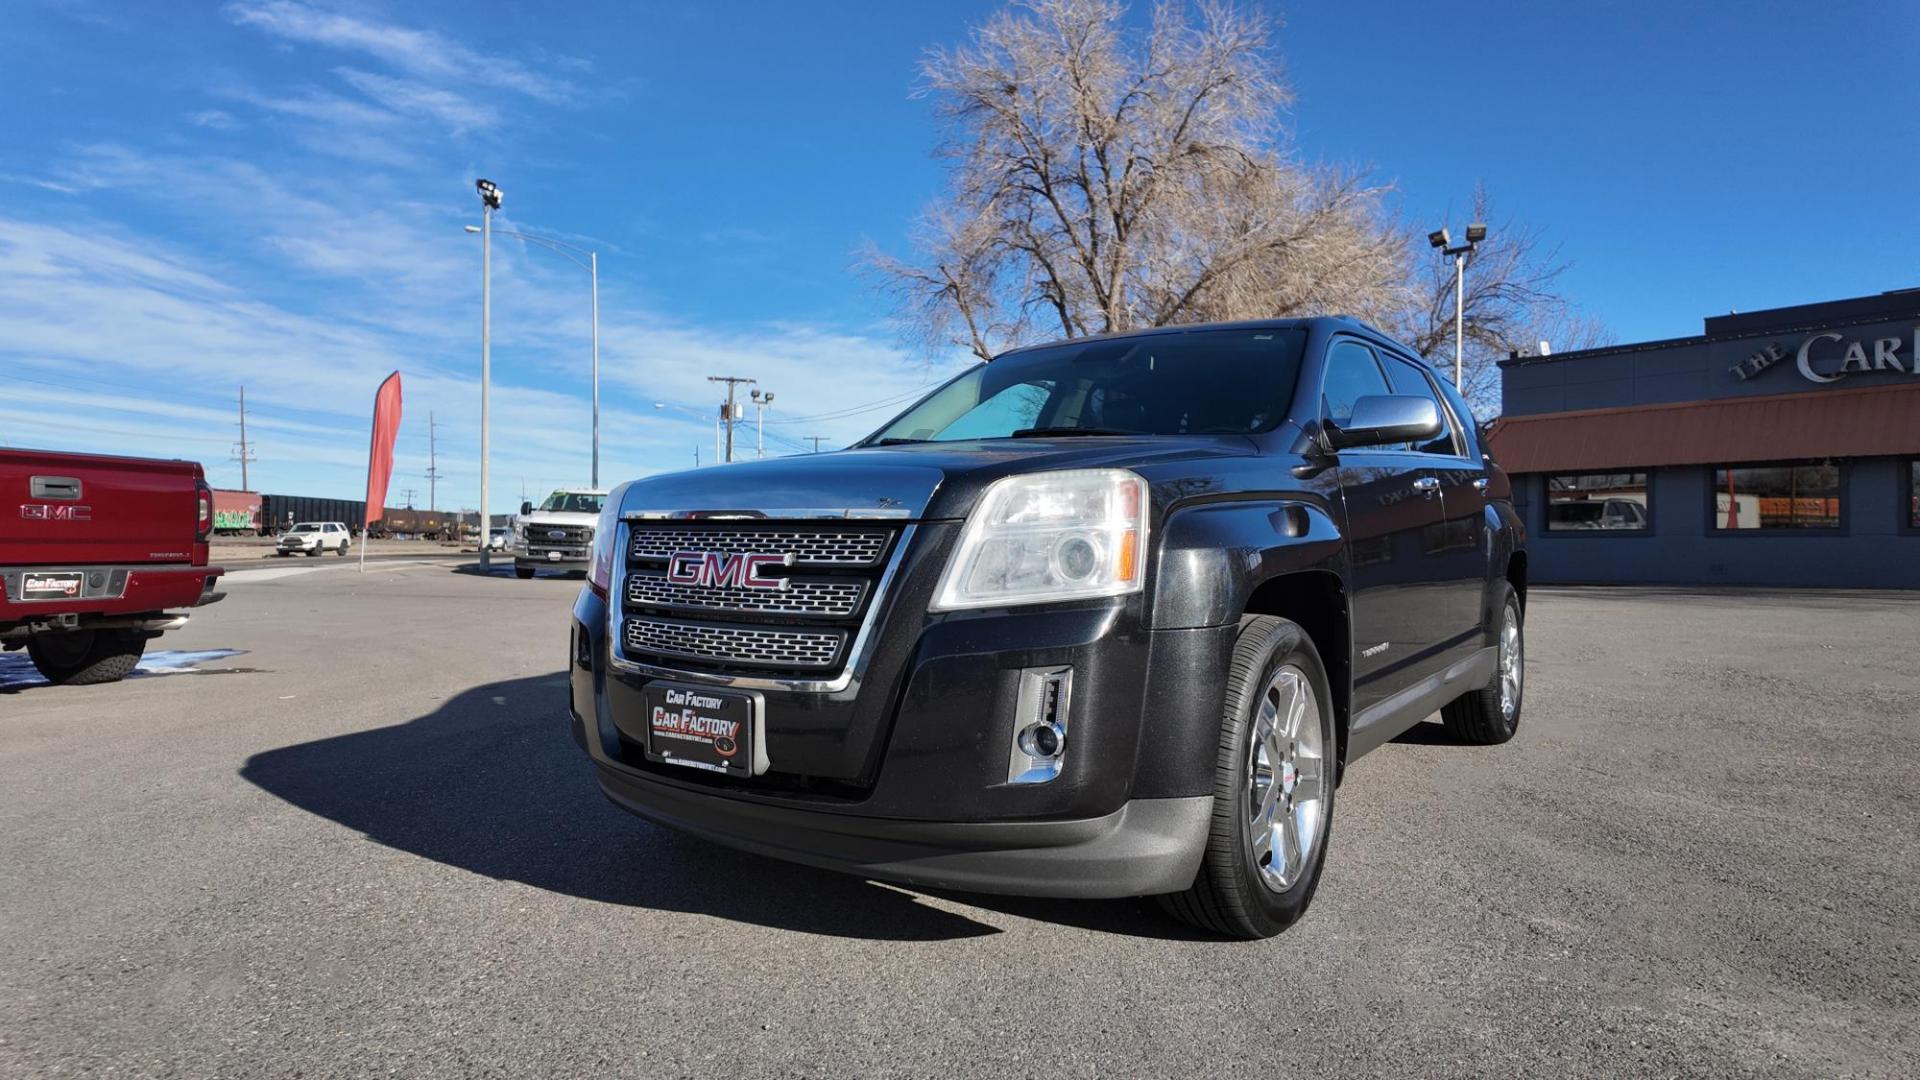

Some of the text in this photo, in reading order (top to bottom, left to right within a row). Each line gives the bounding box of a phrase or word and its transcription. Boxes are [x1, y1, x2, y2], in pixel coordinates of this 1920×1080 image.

[1728, 342, 1786, 381] THE
[1796, 333, 1905, 383] CAR
[20, 504, 92, 520] GMC
[667, 551, 797, 591] GMC
[666, 689, 722, 709] CAR FACTORY
[652, 706, 738, 737] CAR FACTORY
